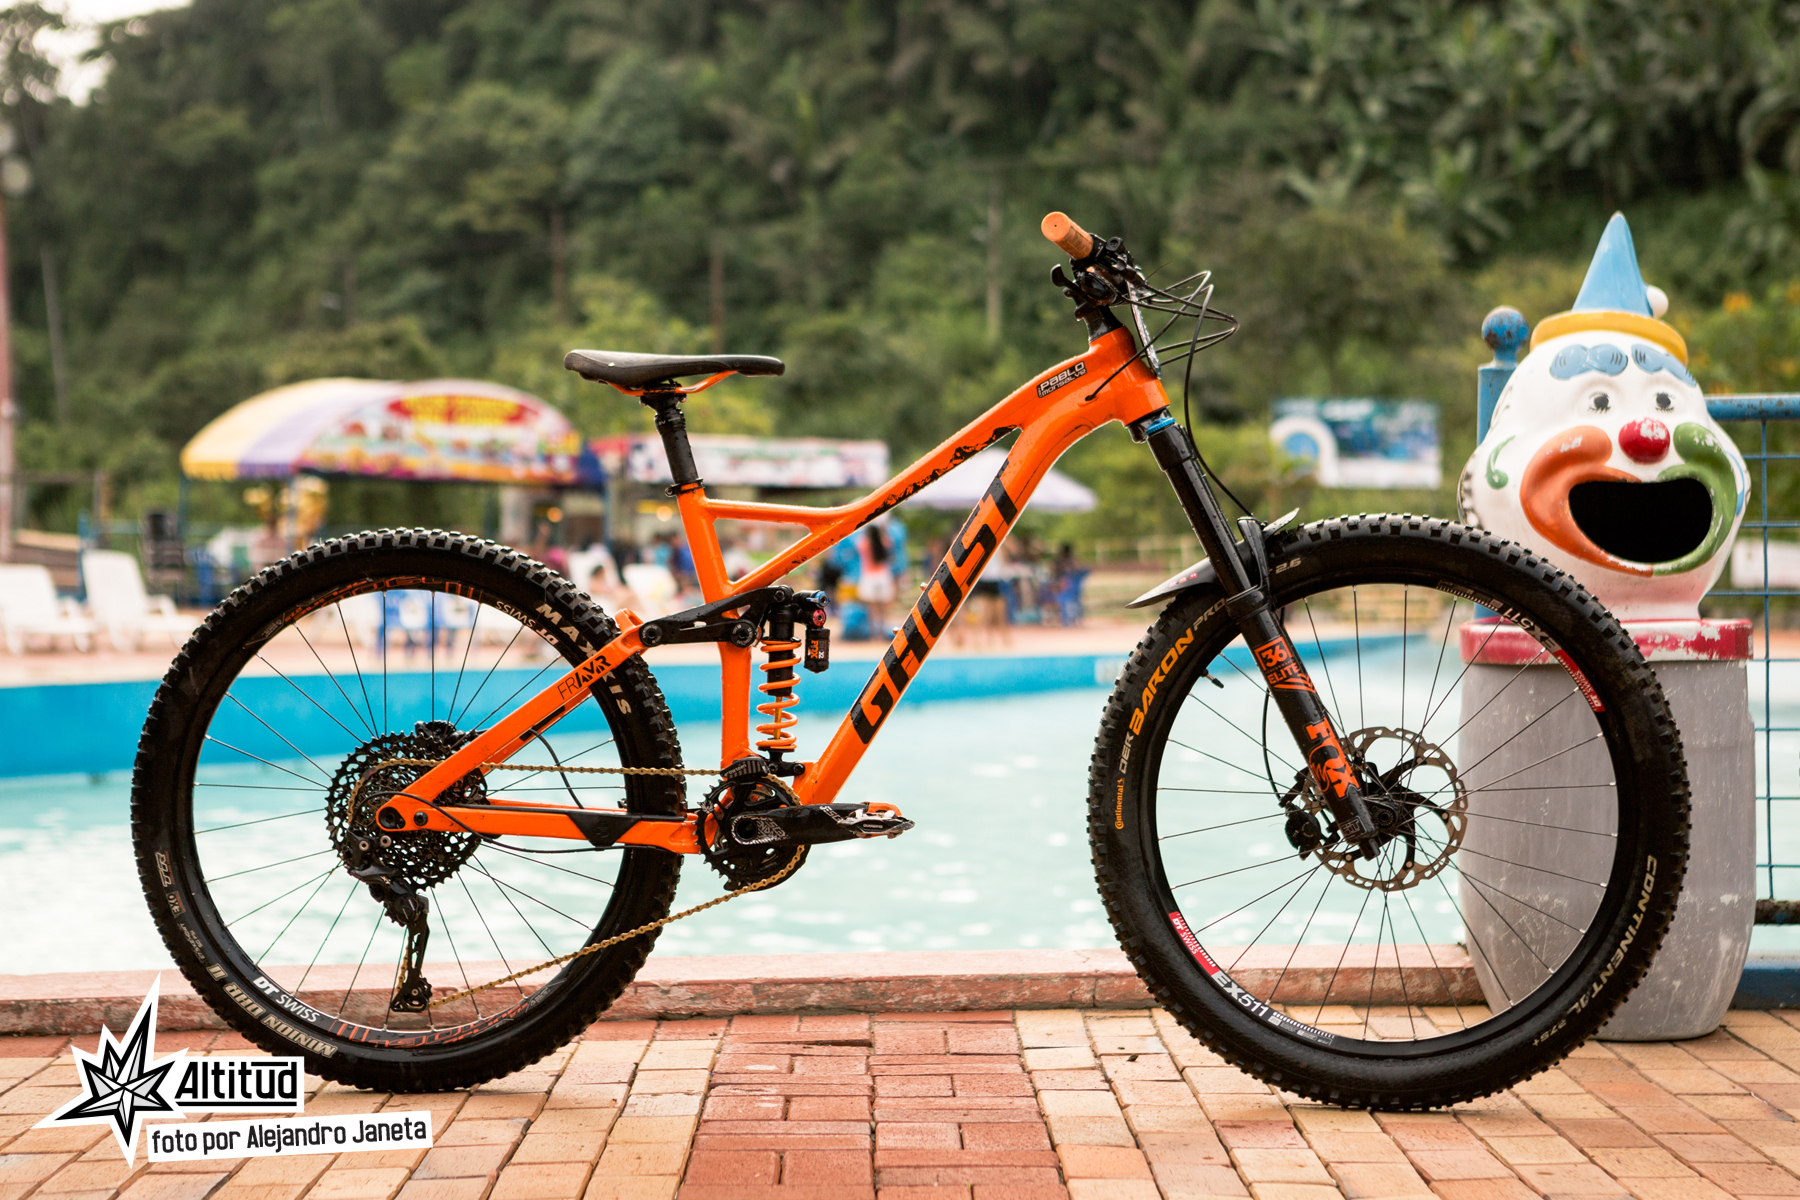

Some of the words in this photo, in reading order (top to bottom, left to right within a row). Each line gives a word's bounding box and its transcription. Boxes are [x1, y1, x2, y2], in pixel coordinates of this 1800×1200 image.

[1274, 557, 1302, 575] 2.6
[496, 600, 536, 628] SWISS
[850, 457, 1019, 745] GHOST
[1193, 597, 1226, 632] PRO
[535, 627, 559, 646] DT
[809, 640, 819, 659] FOX
[1261, 644, 1288, 667] 36
[1129, 627, 1194, 736] BARON
[1267, 662, 1300, 685] ELITE
[1575, 670, 1593, 695] SWISS
[1119, 731, 1135, 774] DER
[1304, 716, 1362, 799] FOX
[166, 892, 181, 915] EXO
[1172, 918, 1184, 930] DT
[1180, 931, 1199, 955] SWISS
[206, 963, 229, 981] II
[252, 976, 280, 995] DT
[275, 994, 320, 1022] SWISS
[1211, 970, 1270, 1017] EX511
[261, 1013, 338, 1058] MINION
